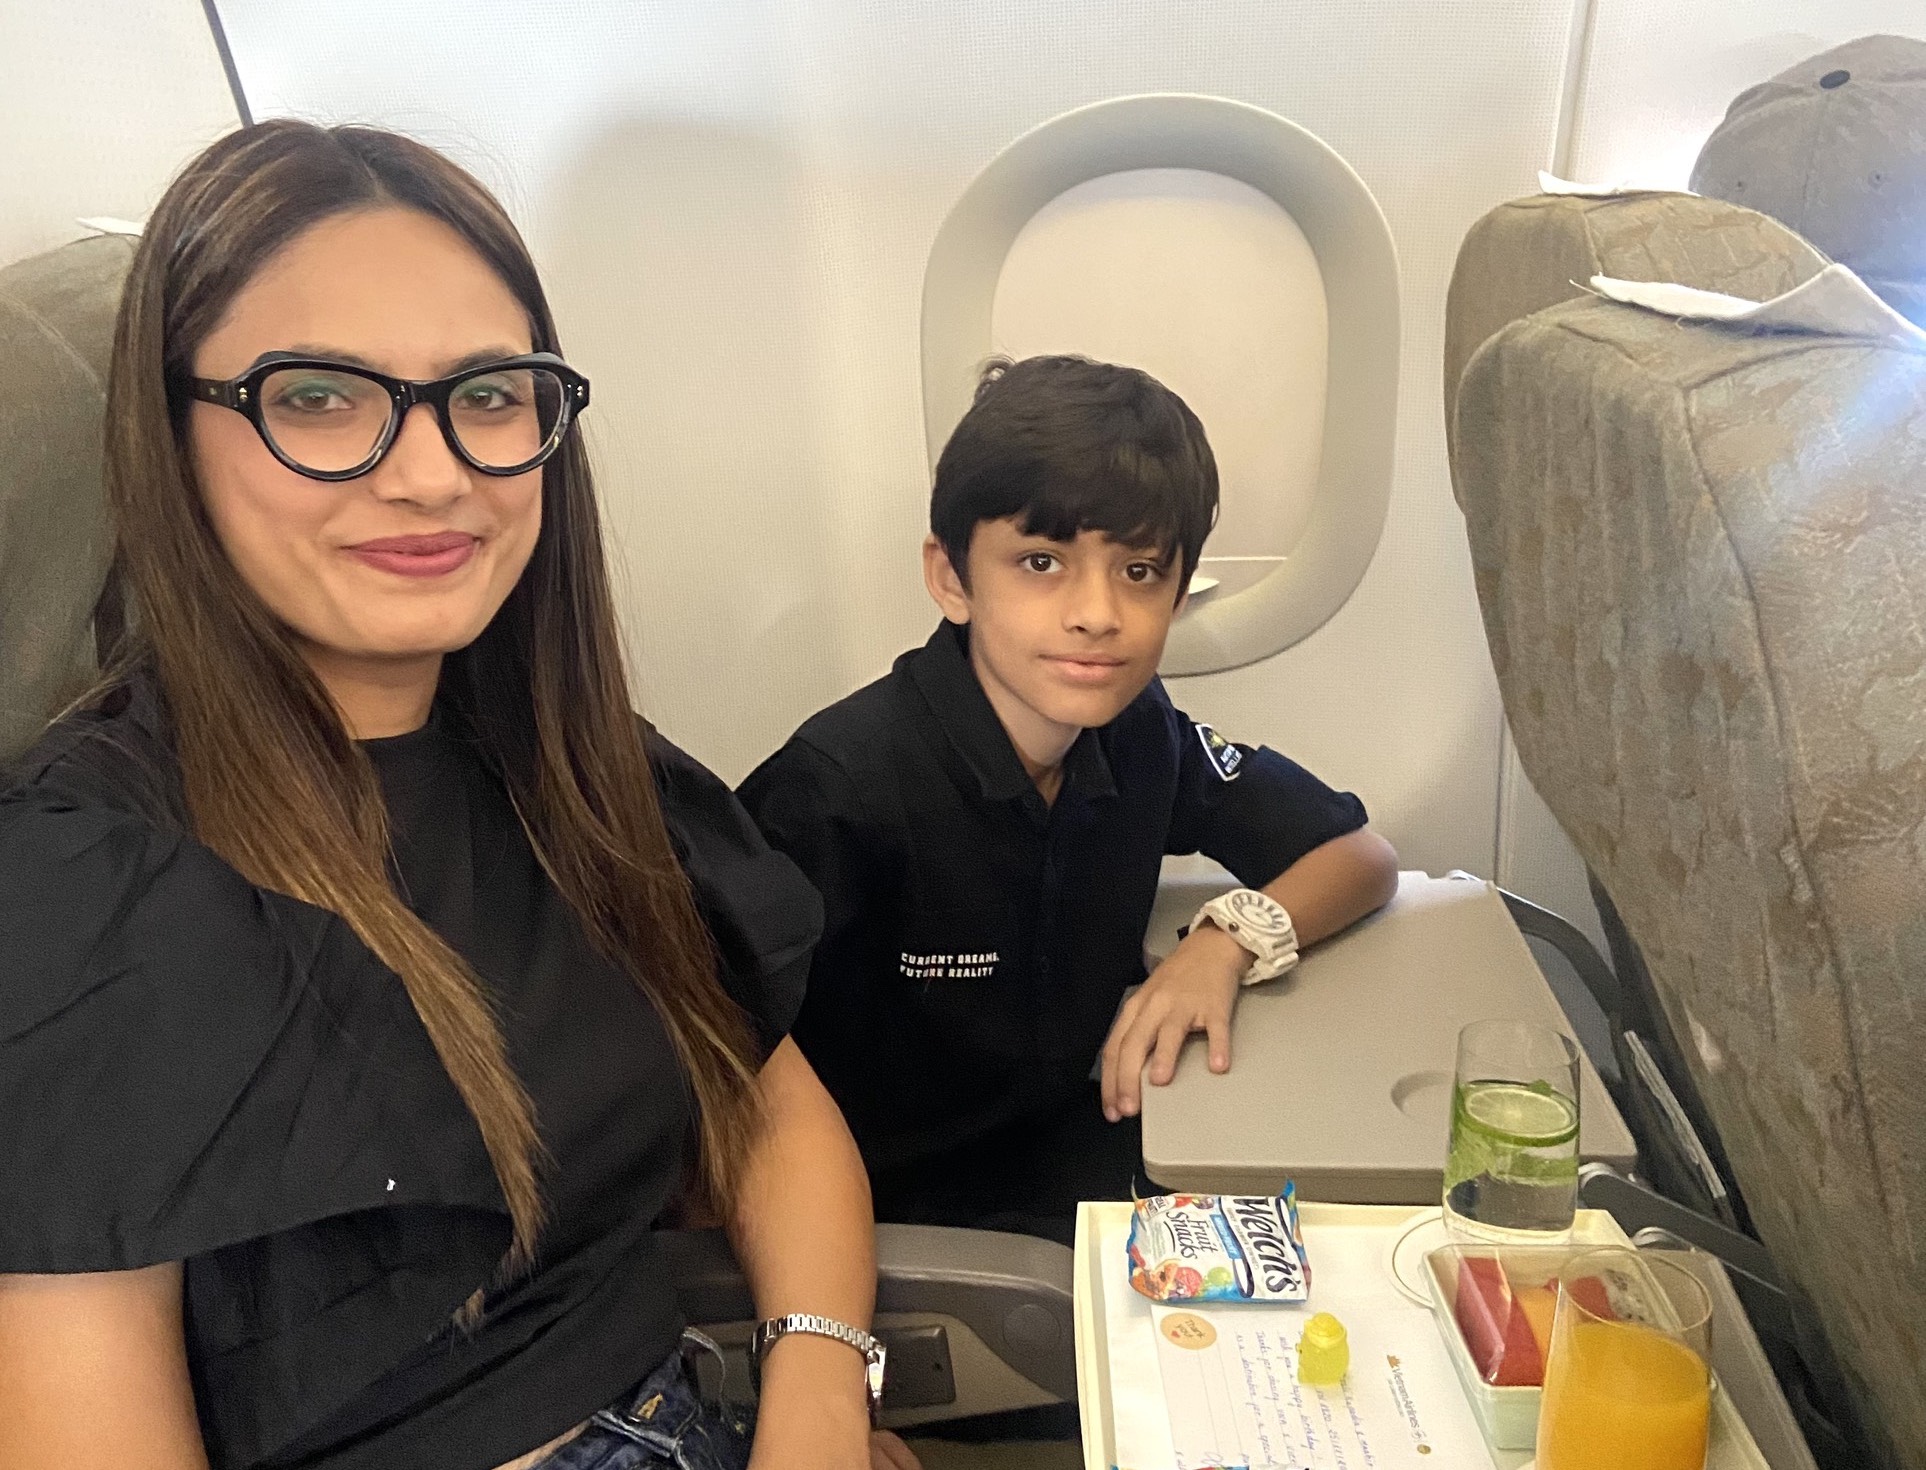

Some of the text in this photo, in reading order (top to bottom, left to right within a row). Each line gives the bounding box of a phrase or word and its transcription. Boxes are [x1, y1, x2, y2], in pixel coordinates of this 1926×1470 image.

[900, 964, 993, 978] FUTURE REALITY
[901, 952, 954, 966] CURRENT
[1166, 1212, 1198, 1258] Snacks
[1186, 1219, 1218, 1253] Fruit
[1233, 1198, 1301, 1293] Welch's
[1391, 1368, 1408, 1400] Vietnam
[1286, 1385, 1303, 1407] happy
[1299, 1414, 1320, 1450] birthday
